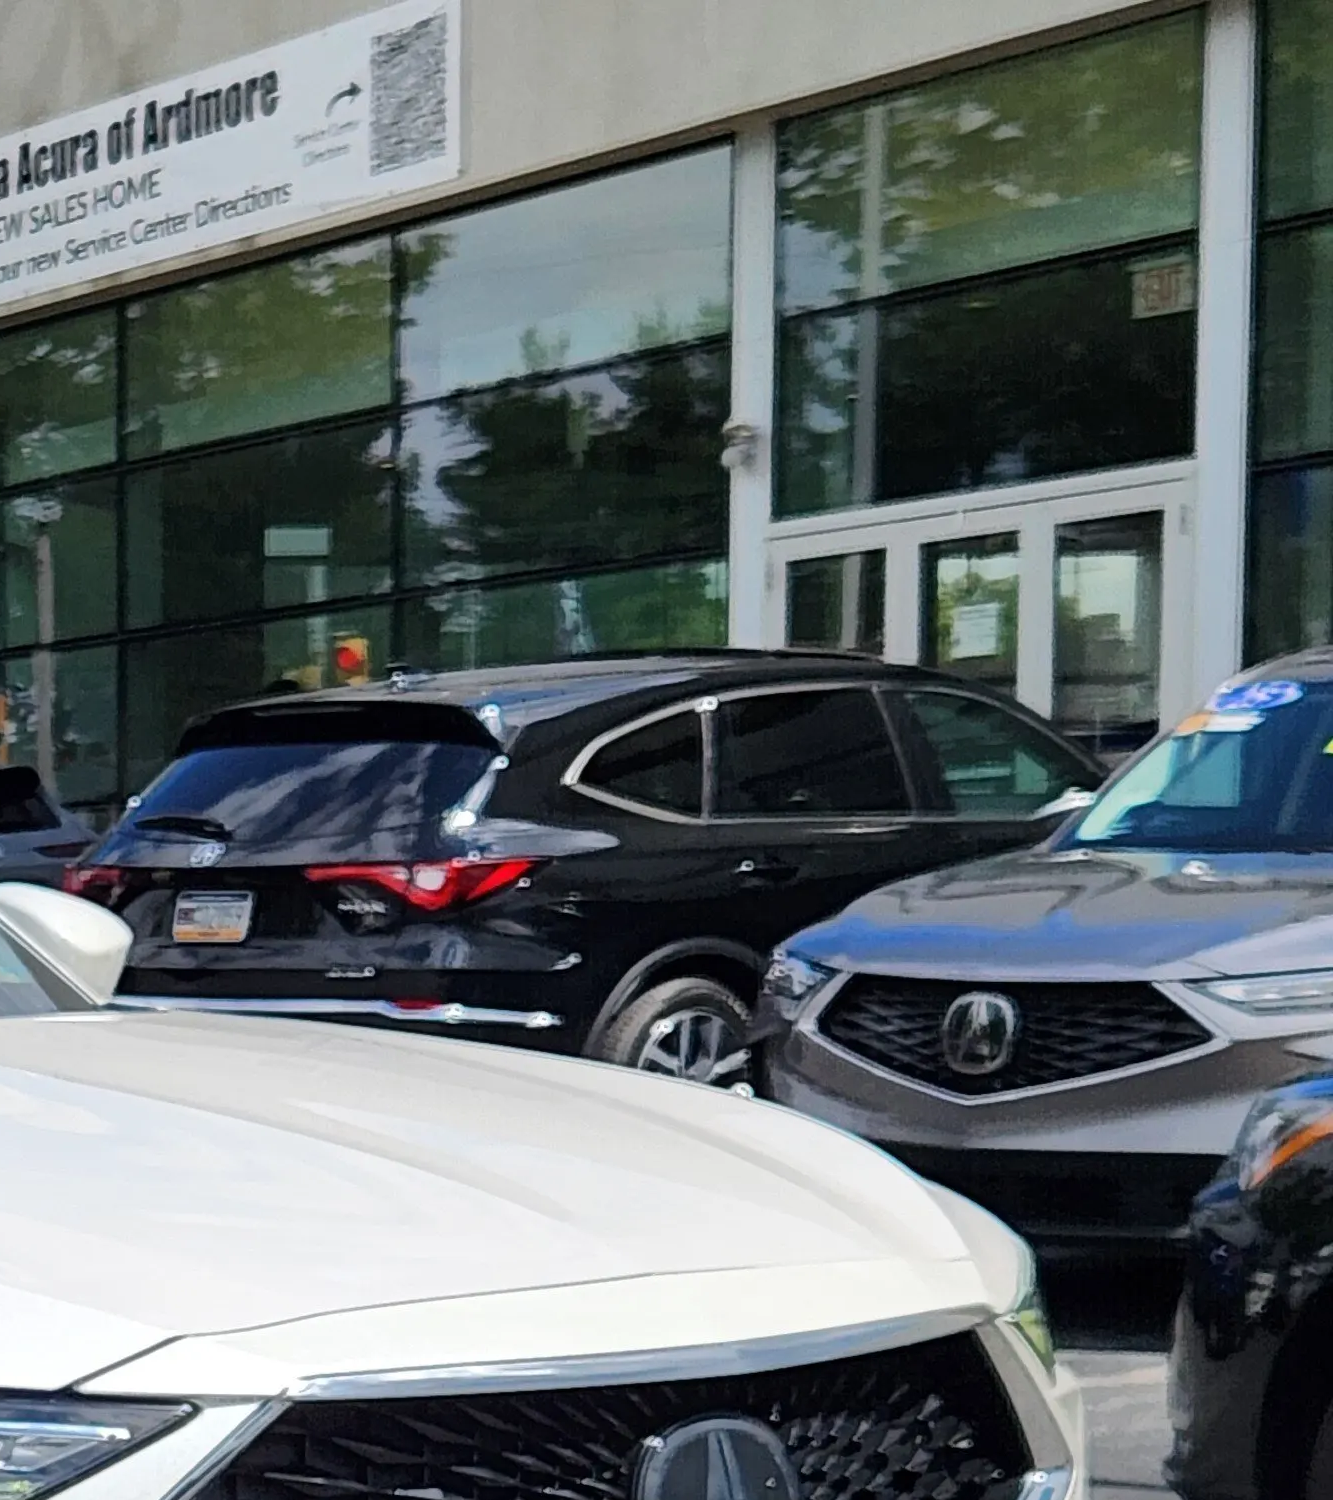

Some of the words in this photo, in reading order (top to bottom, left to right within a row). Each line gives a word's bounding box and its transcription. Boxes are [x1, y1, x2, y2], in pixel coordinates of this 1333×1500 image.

[16, 129, 99, 194] Acura
[106, 107, 137, 166] of
[141, 70, 281, 155] Ardmore
[26, 247, 62, 276] new
[64, 228, 128, 262] Service
[129, 210, 194, 245] Center
[195, 182, 294, 229] Directions
[28, 191, 88, 235] SALES
[92, 168, 163, 213] HOME
